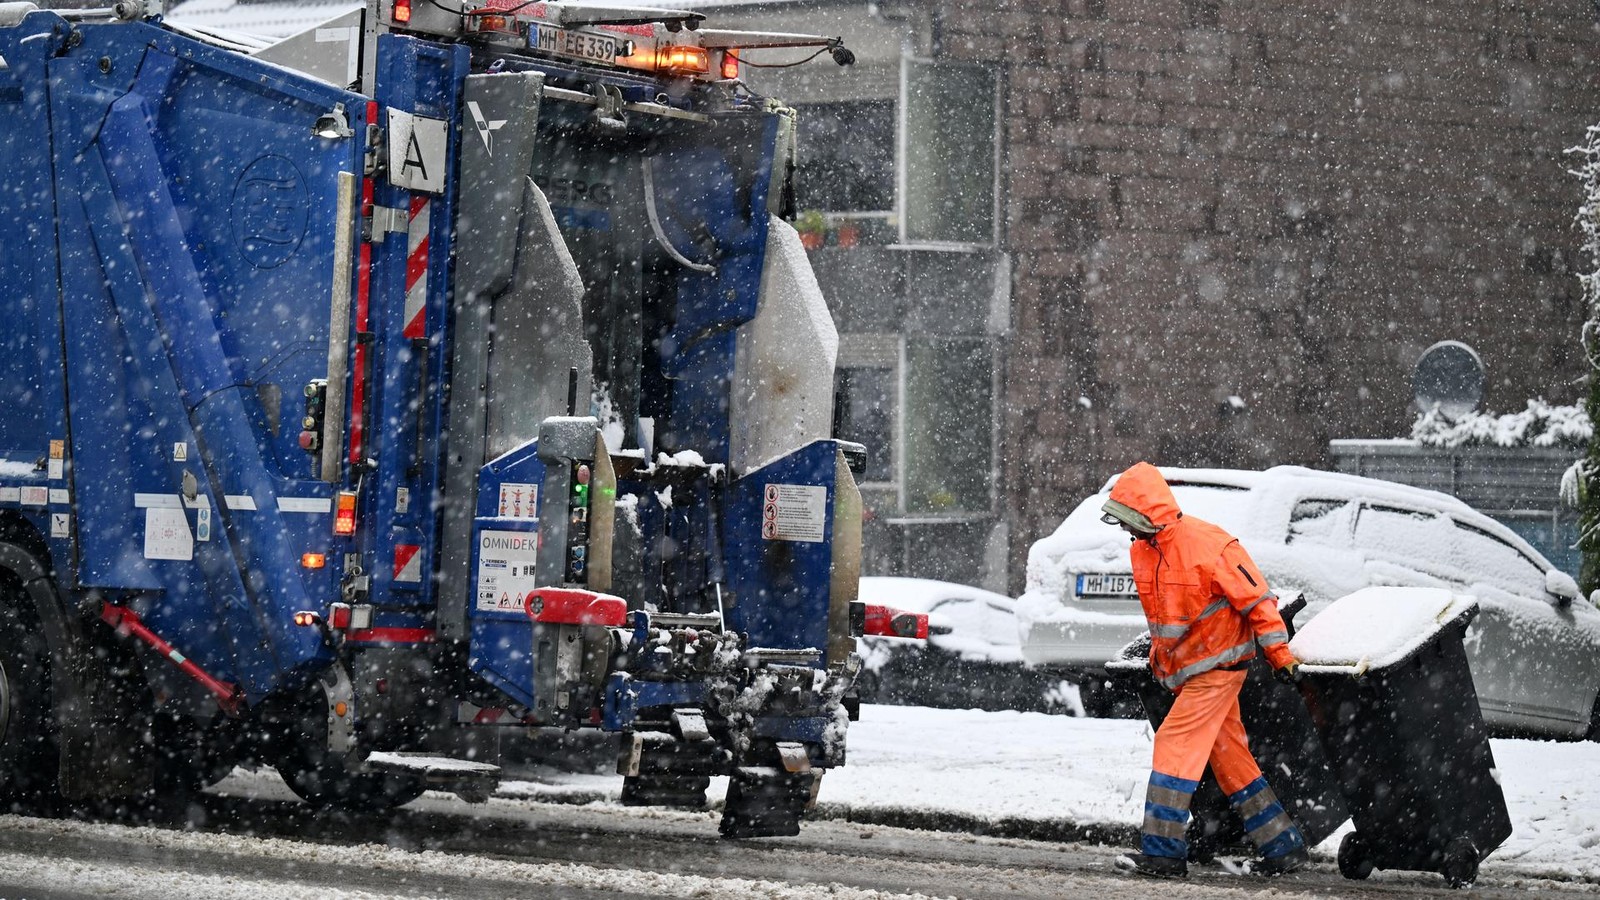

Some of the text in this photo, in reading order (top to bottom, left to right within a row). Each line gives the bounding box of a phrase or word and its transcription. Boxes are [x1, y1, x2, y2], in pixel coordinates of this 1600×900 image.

[539, 28, 613, 59] MH EG 339
[401, 127, 428, 180] A
[482, 537, 535, 551] OMNIDEK
[1087, 577, 1102, 592] MH
